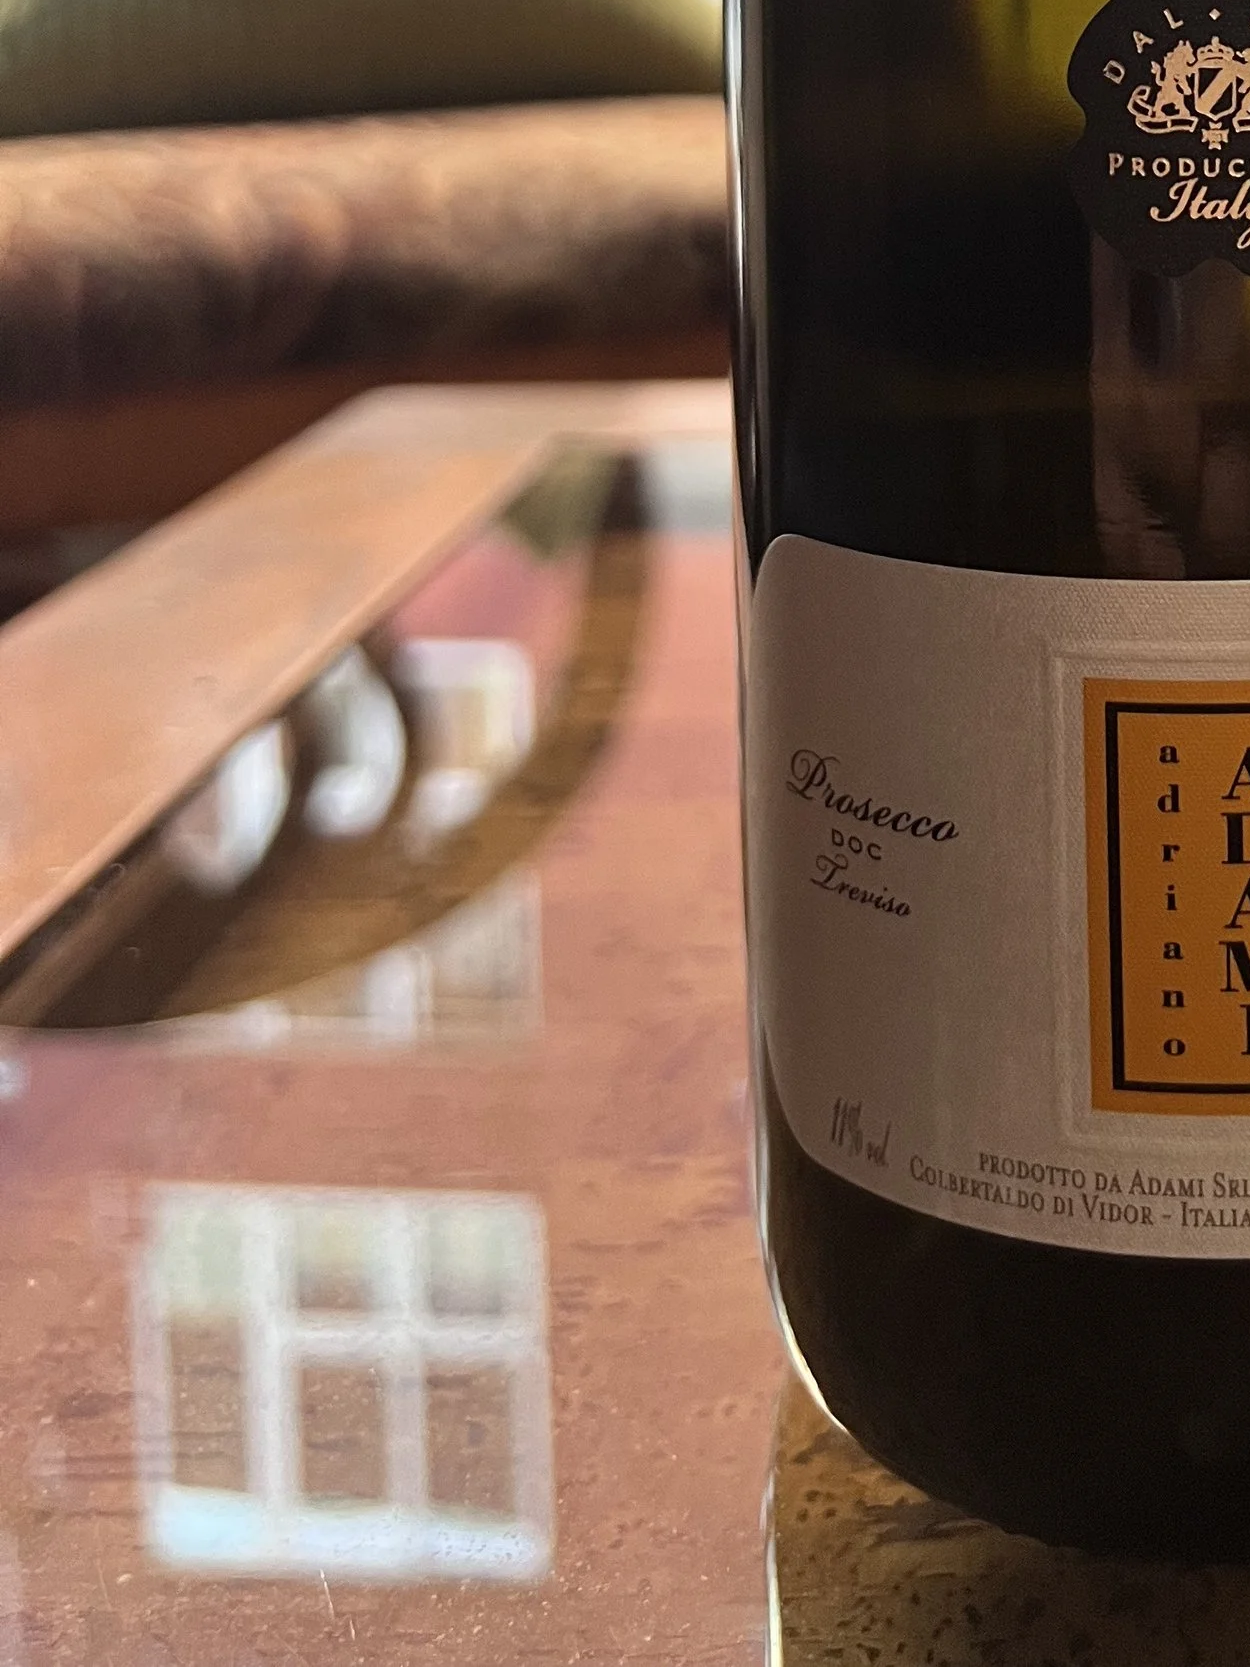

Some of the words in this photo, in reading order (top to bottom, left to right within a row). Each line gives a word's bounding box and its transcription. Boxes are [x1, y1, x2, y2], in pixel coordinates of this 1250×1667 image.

[1103, 8, 1183, 84] DAL
[786, 749, 959, 842] Prosecco
[831, 828, 882, 861] DOC
[810, 853, 911, 917] Treviso
[1157, 744, 1186, 1056] adriano
[979, 1152, 1086, 1190] PRODOTTO
